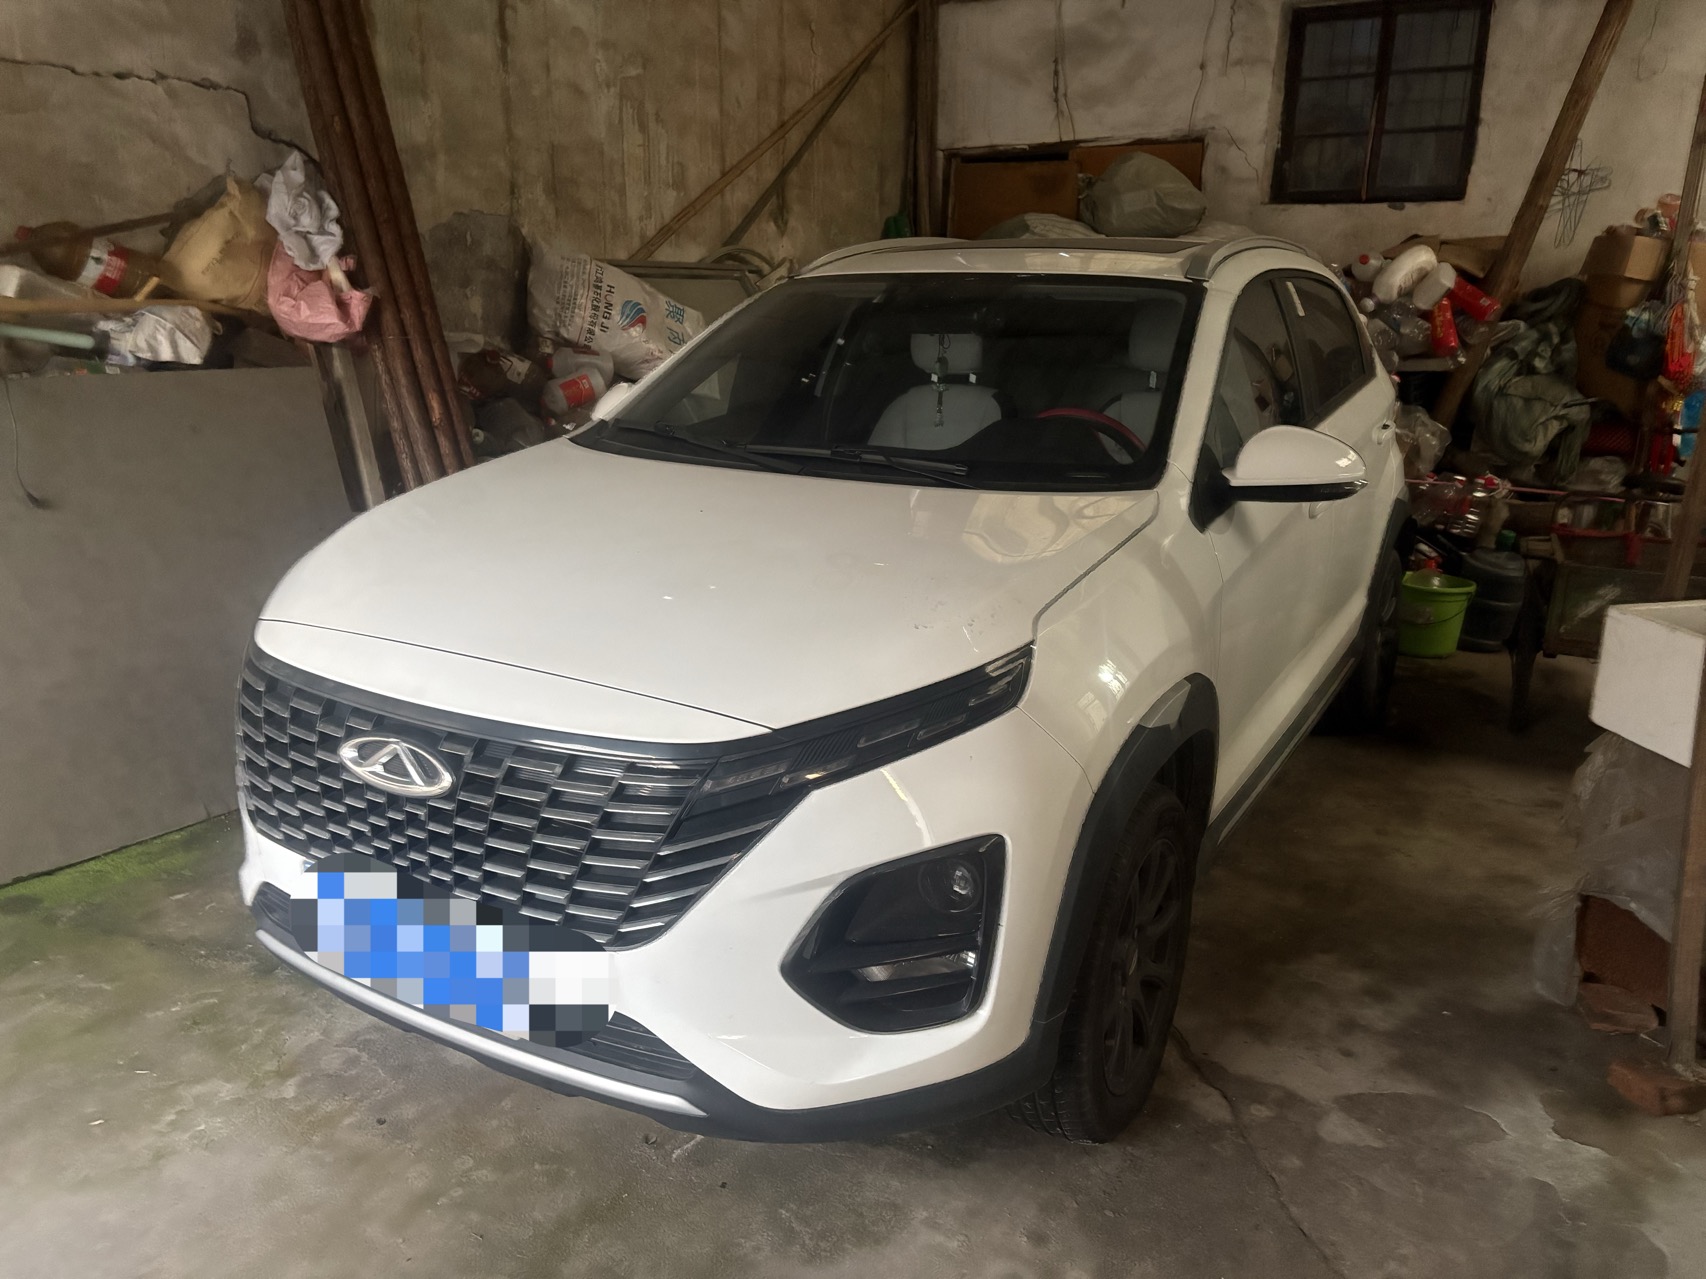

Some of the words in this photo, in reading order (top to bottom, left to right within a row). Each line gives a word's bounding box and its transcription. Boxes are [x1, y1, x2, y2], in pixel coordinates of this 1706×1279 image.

[602, 284, 615, 321] HONG
[599, 322, 609, 333] JI
[664, 300, 688, 355] 聚丙
